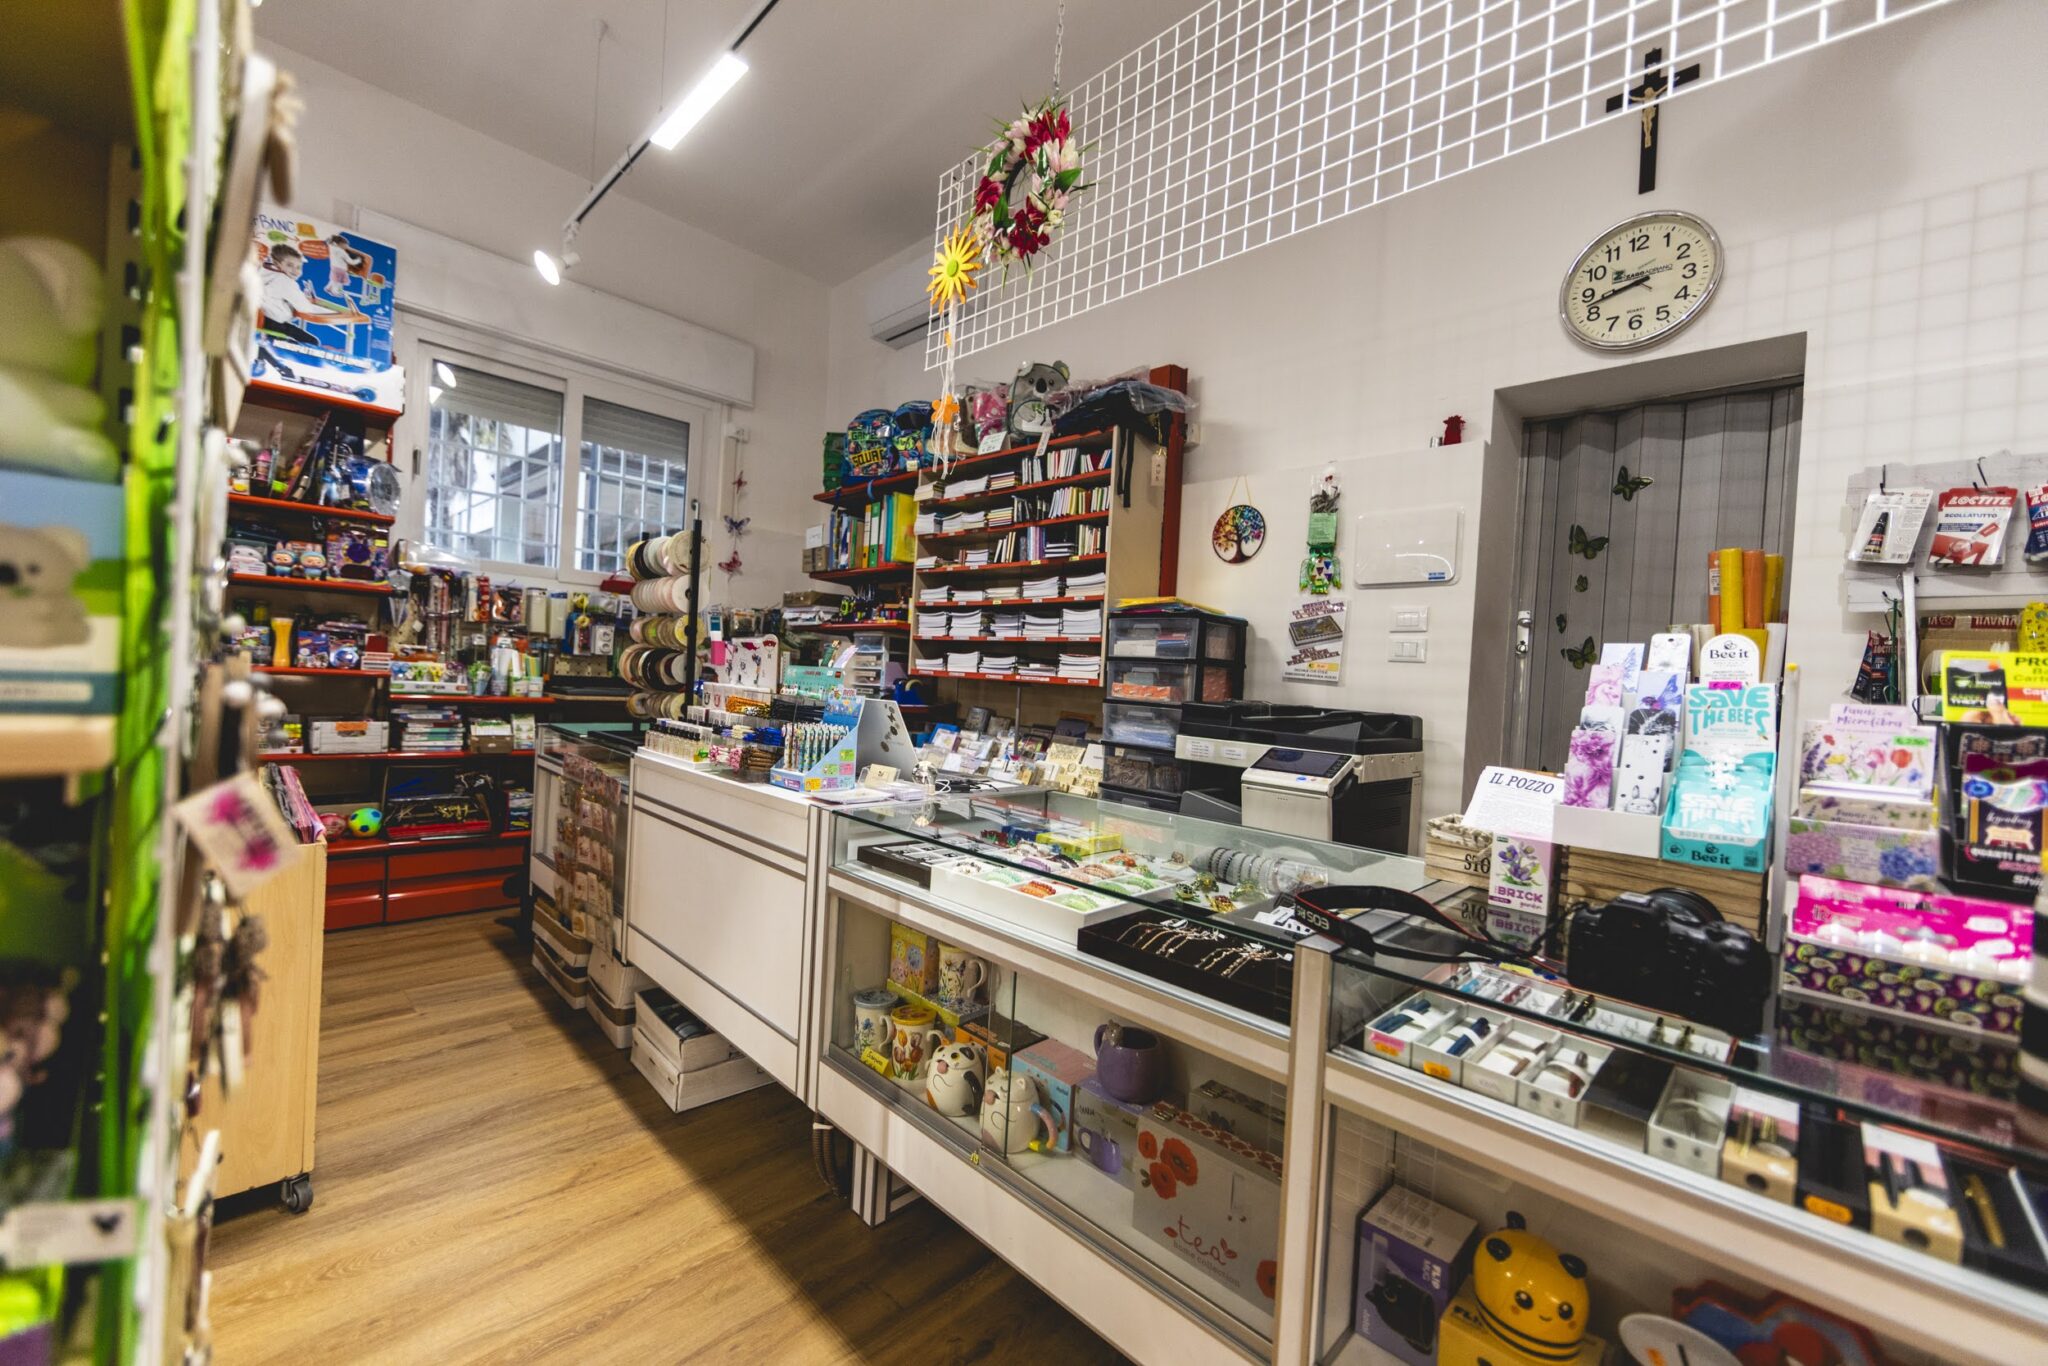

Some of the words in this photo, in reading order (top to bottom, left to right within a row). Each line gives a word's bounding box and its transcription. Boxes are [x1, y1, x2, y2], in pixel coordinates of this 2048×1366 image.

[1629, 235, 1650, 253] 12
[1663, 232, 1671, 248] 1
[1604, 246, 1620, 263] 11
[1676, 243, 1691, 260] 2
[1586, 265, 1607, 282] 10
[1681, 263, 1697, 279] 3
[1582, 288, 1595, 303] 9
[1674, 285, 1690, 300] 4
[1586, 306, 1600, 322] 8
[1655, 305, 1670, 321] 5
[1605, 316, 1620, 332] 7
[1628, 315, 1643, 330] 6
[1950, 496, 2012, 505] LOCTITE
[1710, 649, 1736, 659] Bee
[1739, 648, 1749, 659] it
[1689, 686, 1770, 708] SAVE
[1689, 709, 1725, 735] THE
[1728, 708, 1771, 736] BEES
[1489, 772, 1503, 785] IL
[1506, 775, 1555, 794] POZZO
[1691, 850, 1718, 863] Bee
[1720, 853, 1731, 865] it
[1497, 886, 1543, 904] BRICK
[1178, 1214, 1227, 1266] tea
